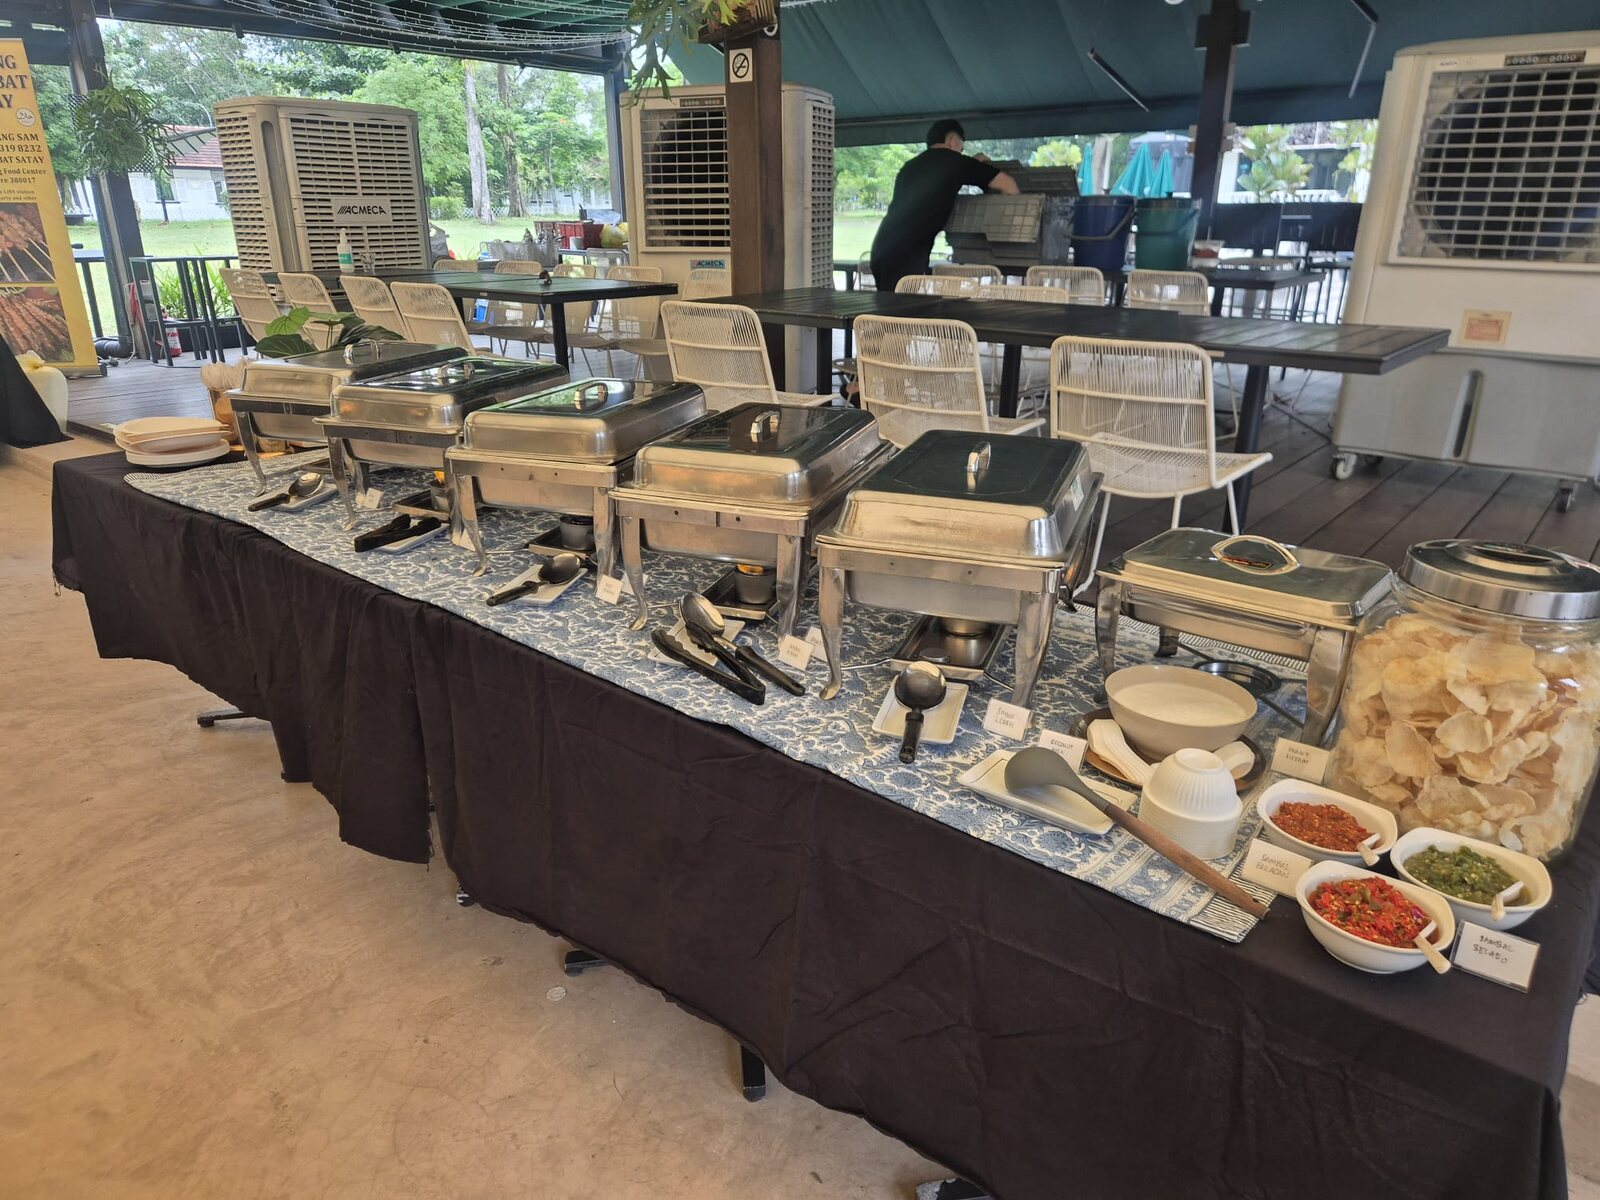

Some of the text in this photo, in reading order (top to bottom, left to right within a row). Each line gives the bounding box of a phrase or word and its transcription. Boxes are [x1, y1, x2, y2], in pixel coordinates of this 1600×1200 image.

[0, 133, 39, 142] NG SAM
[18, 144, 42, 152] 8232
[15, 156, 44, 164] SATAY
[345, 206, 386, 214] ACMECA
